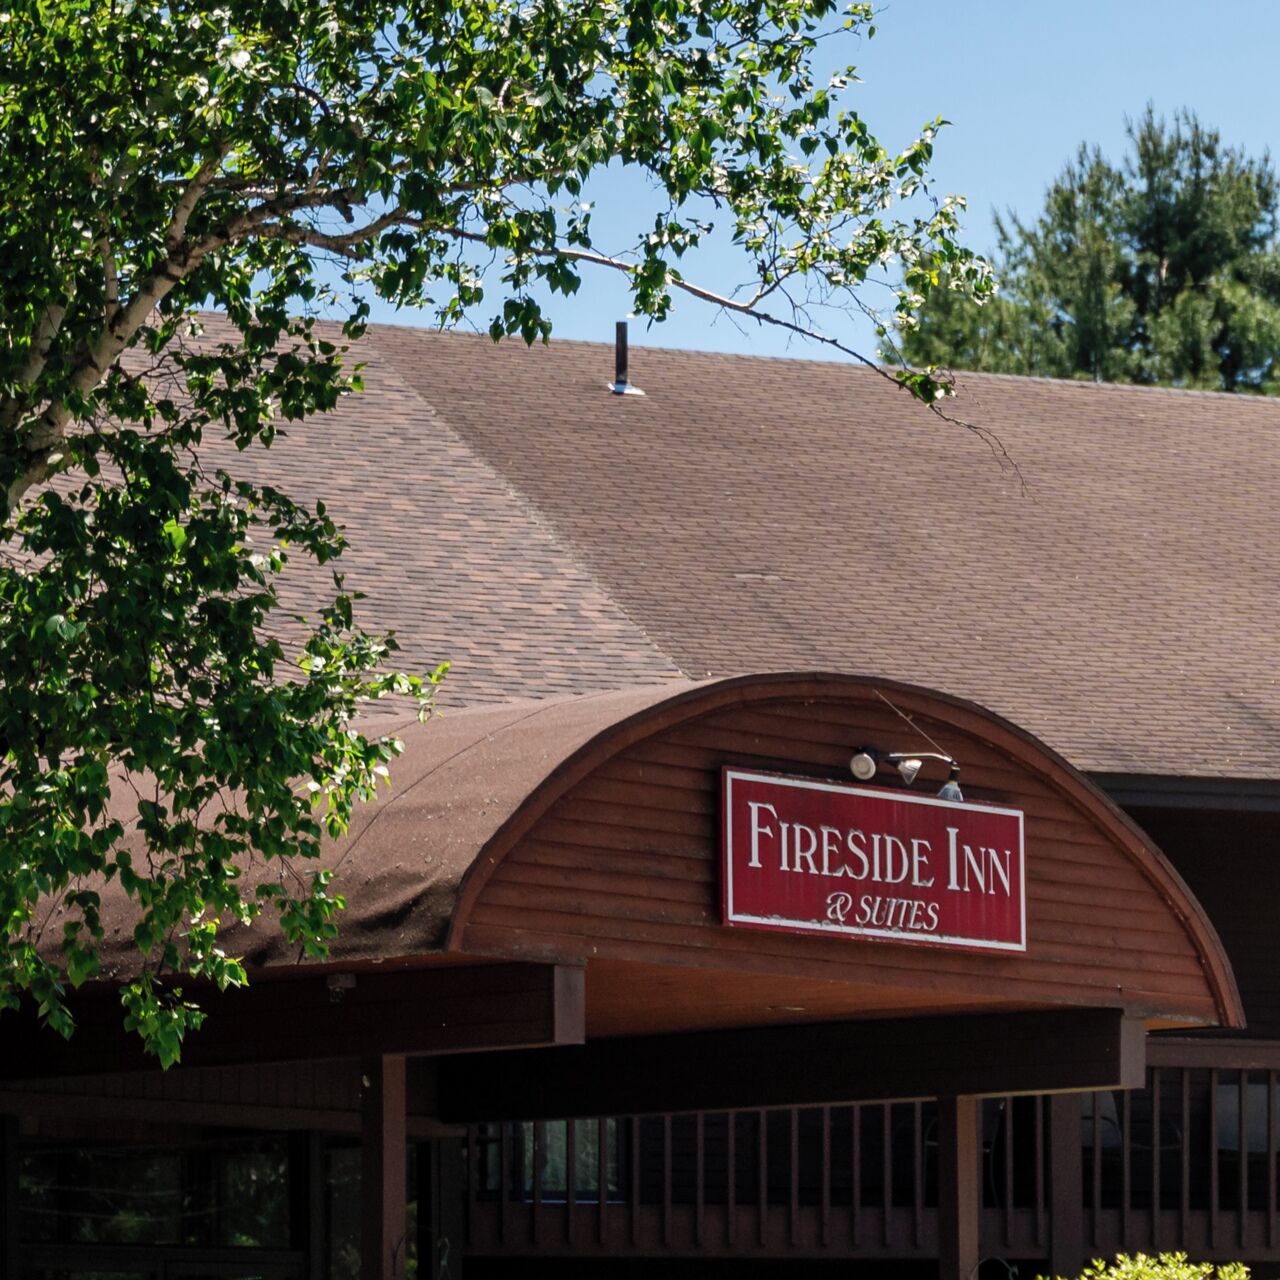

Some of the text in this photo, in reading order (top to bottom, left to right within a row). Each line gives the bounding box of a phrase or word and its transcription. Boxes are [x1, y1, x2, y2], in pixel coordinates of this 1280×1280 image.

[747, 801, 1012, 897] FIRESIDE INN
[826, 891, 940, 931] & SUITES
